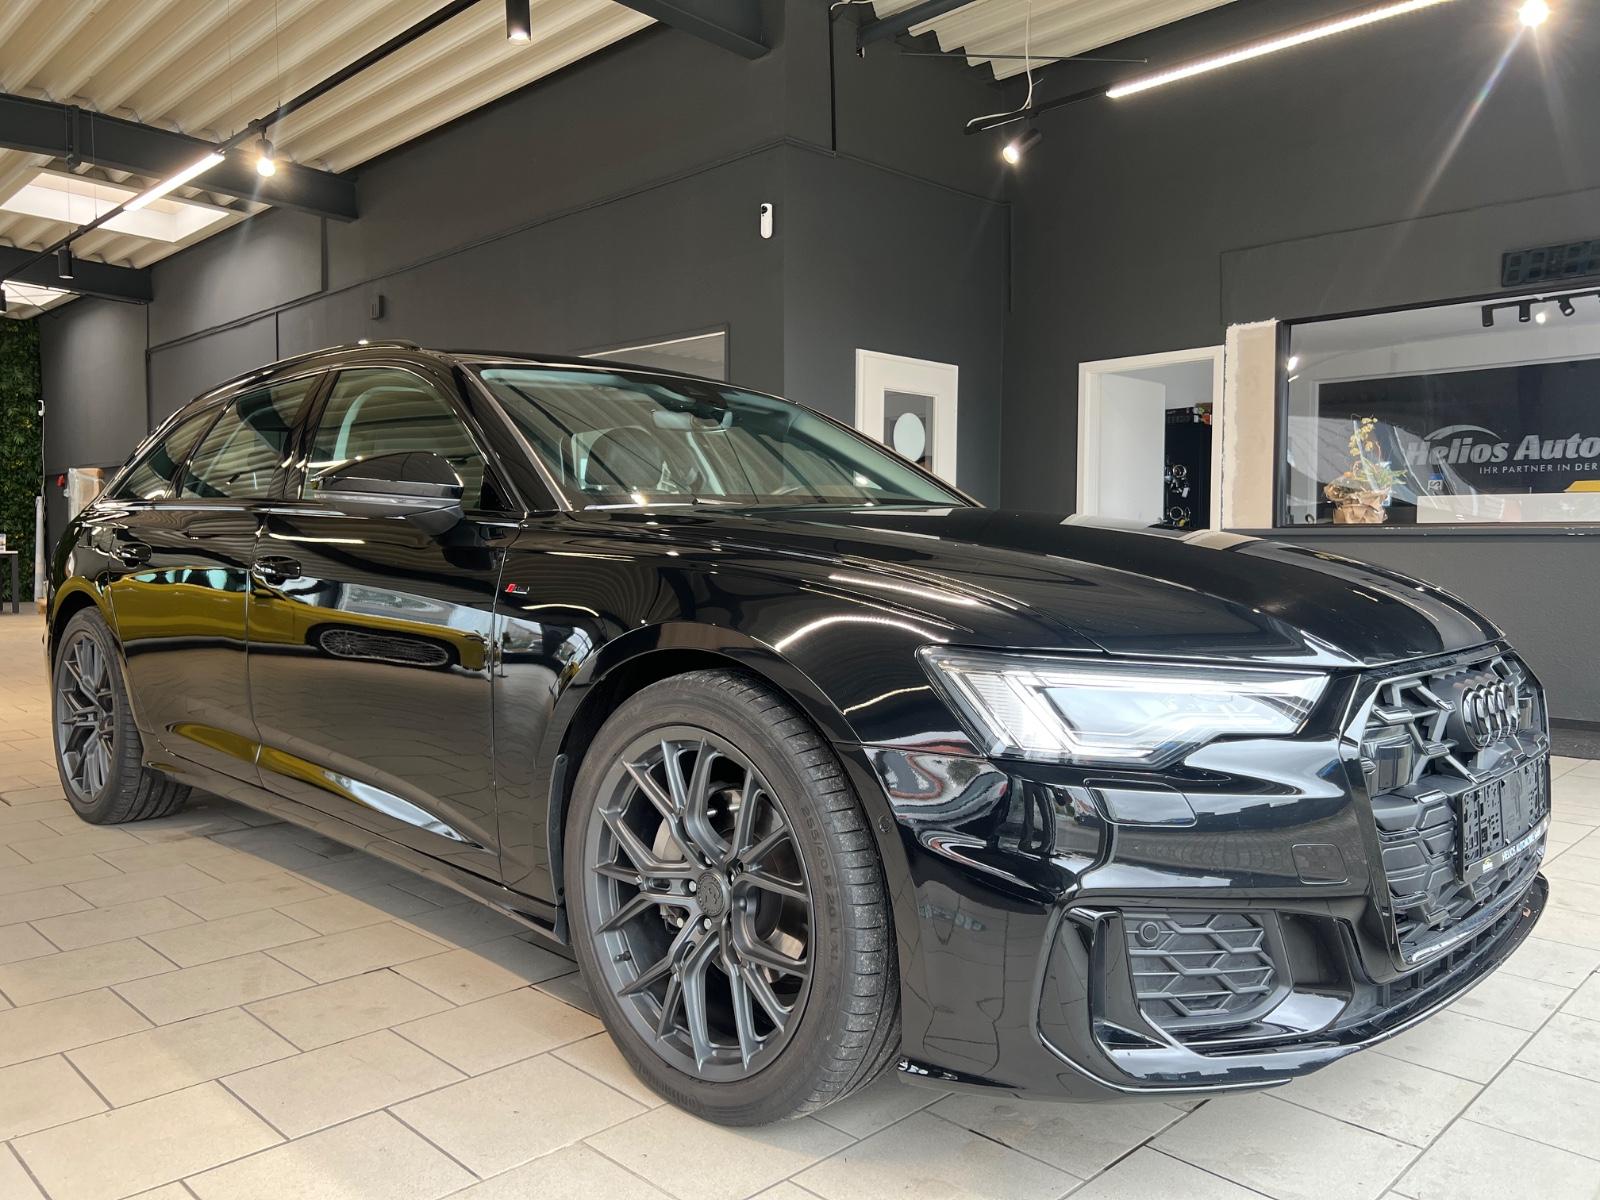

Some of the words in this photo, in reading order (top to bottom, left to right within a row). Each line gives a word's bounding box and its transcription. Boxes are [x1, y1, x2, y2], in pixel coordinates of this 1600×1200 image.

[1406, 437, 1510, 466] Helios
[1513, 433, 1600, 460] Auto
[1479, 466, 1498, 475] IHR
[1502, 464, 1553, 473] PARTNER
[1557, 463, 1571, 471] IN
[1575, 462, 1598, 471] DER
[801, 806, 829, 870] 255/40
